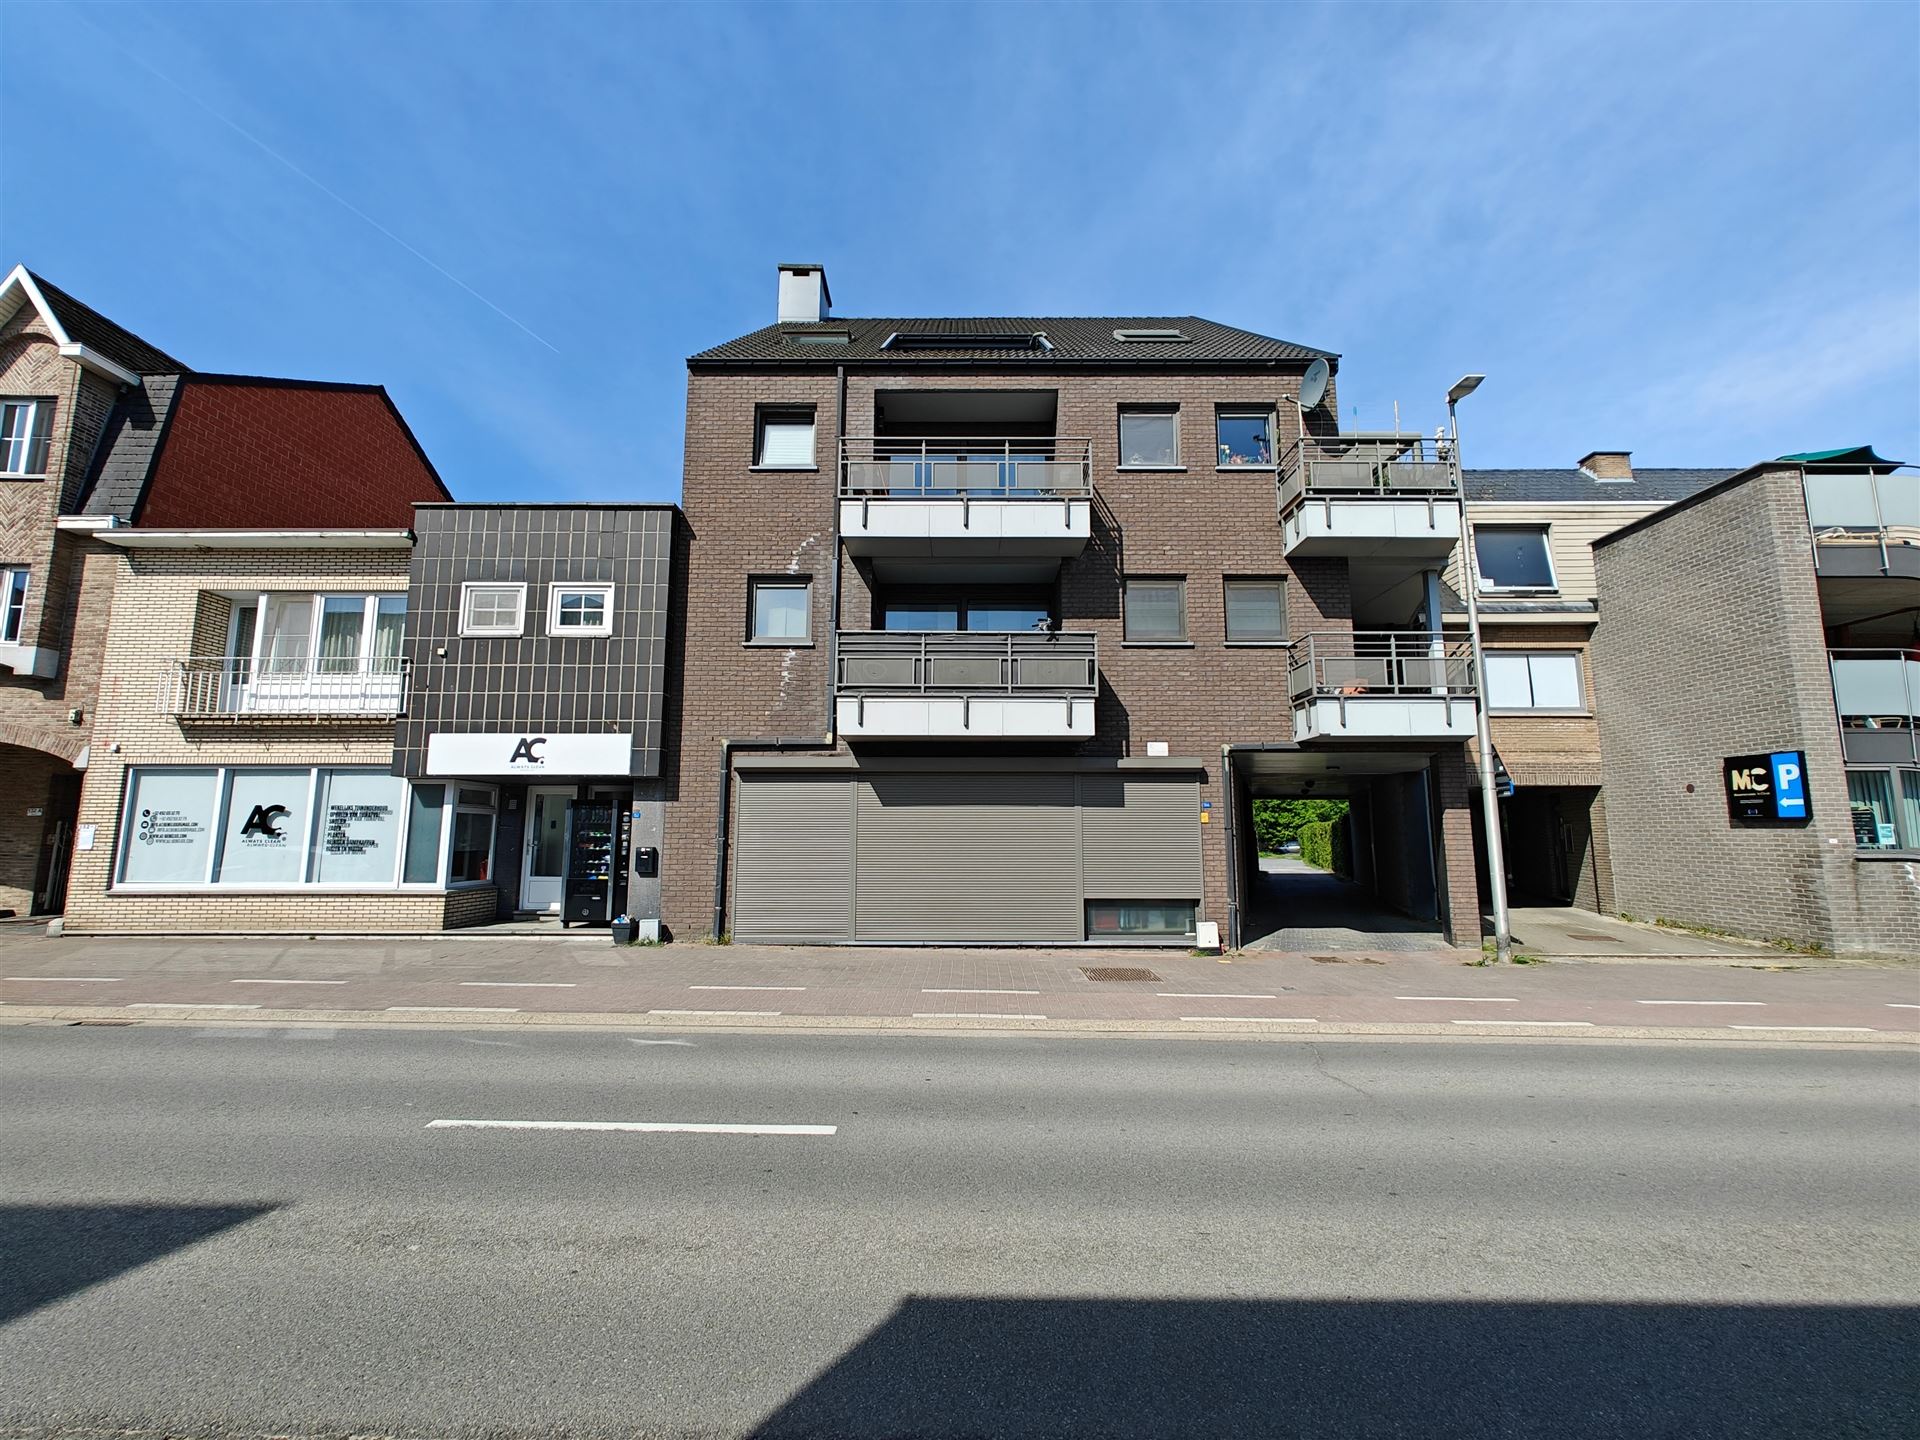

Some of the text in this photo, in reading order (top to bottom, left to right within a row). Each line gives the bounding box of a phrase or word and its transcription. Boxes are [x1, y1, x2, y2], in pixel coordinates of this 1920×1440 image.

[510, 737, 547, 764] AC
[1732, 767, 1769, 791] MC
[1778, 764, 1800, 790] P
[240, 804, 286, 836] AC
